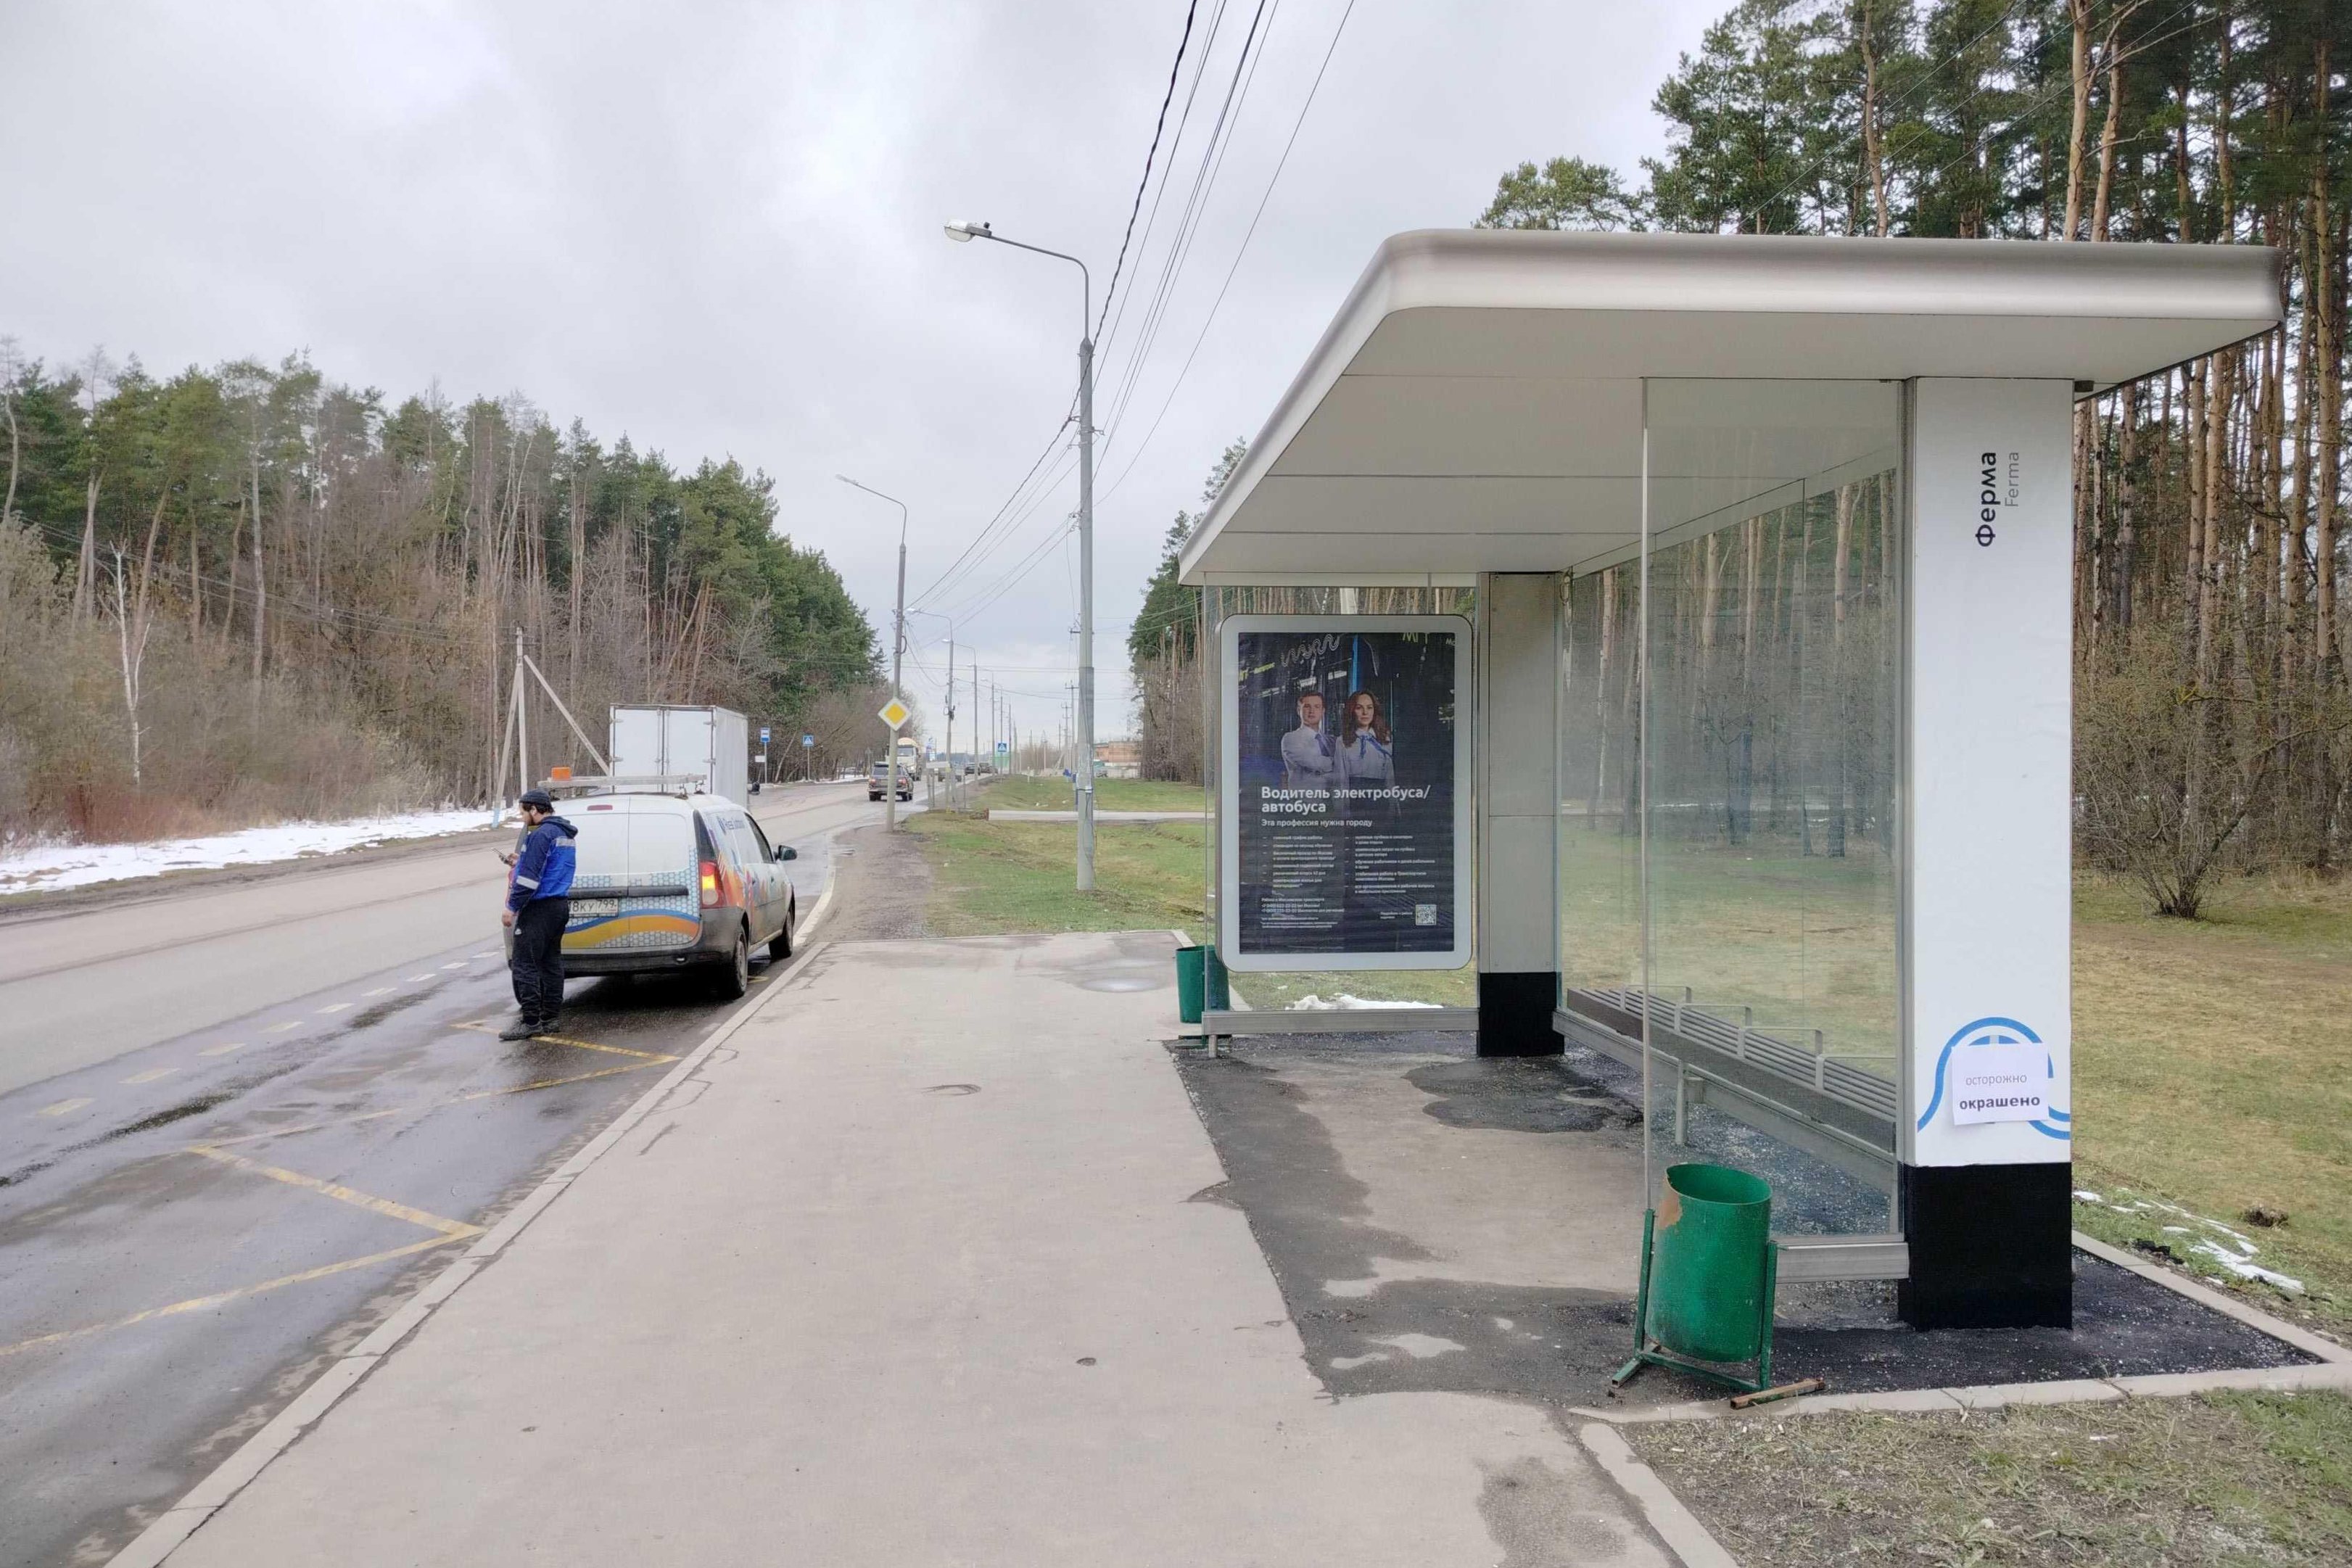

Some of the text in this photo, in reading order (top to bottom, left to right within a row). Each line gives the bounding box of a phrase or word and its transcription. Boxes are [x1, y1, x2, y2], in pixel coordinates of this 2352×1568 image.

[2005, 452, 2019, 507] Ferma
[1975, 452, 2000, 547] Ферма
[1261, 785, 1429, 801] Водитель электробуса/
[1261, 800, 1326, 814] автобуса
[1276, 819, 1319, 828] профессия
[1320, 819, 1344, 828] нужна
[1965, 1074, 2027, 1086] осторожно
[1960, 1097, 2040, 1111] окрашено
